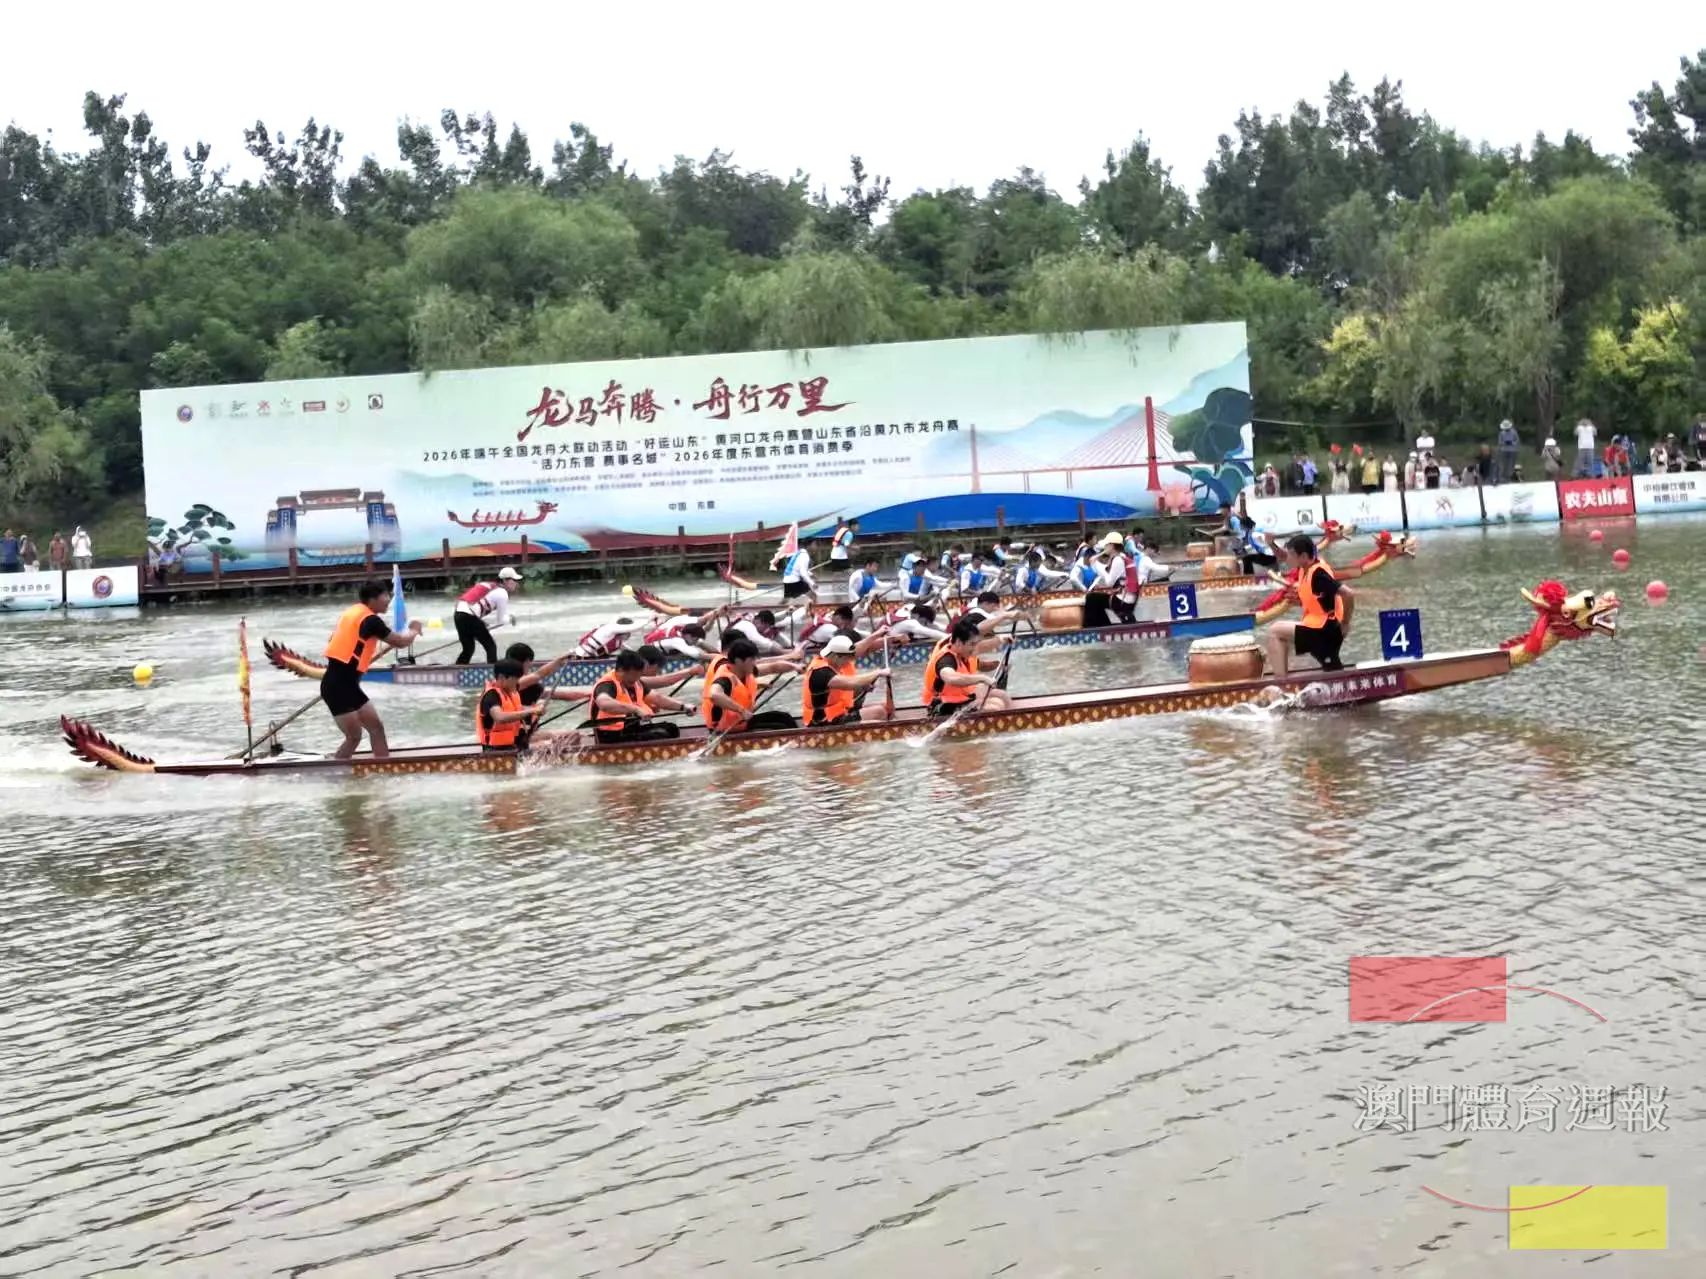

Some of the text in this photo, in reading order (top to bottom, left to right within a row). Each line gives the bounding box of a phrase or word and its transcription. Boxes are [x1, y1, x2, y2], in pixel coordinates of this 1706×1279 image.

[517, 377, 856, 442] 龙马奔腾·舟行万里
[1565, 488, 1628, 509] 农夫山泉
[1175, 593, 1190, 614] 3
[1389, 623, 1410, 652] 4
